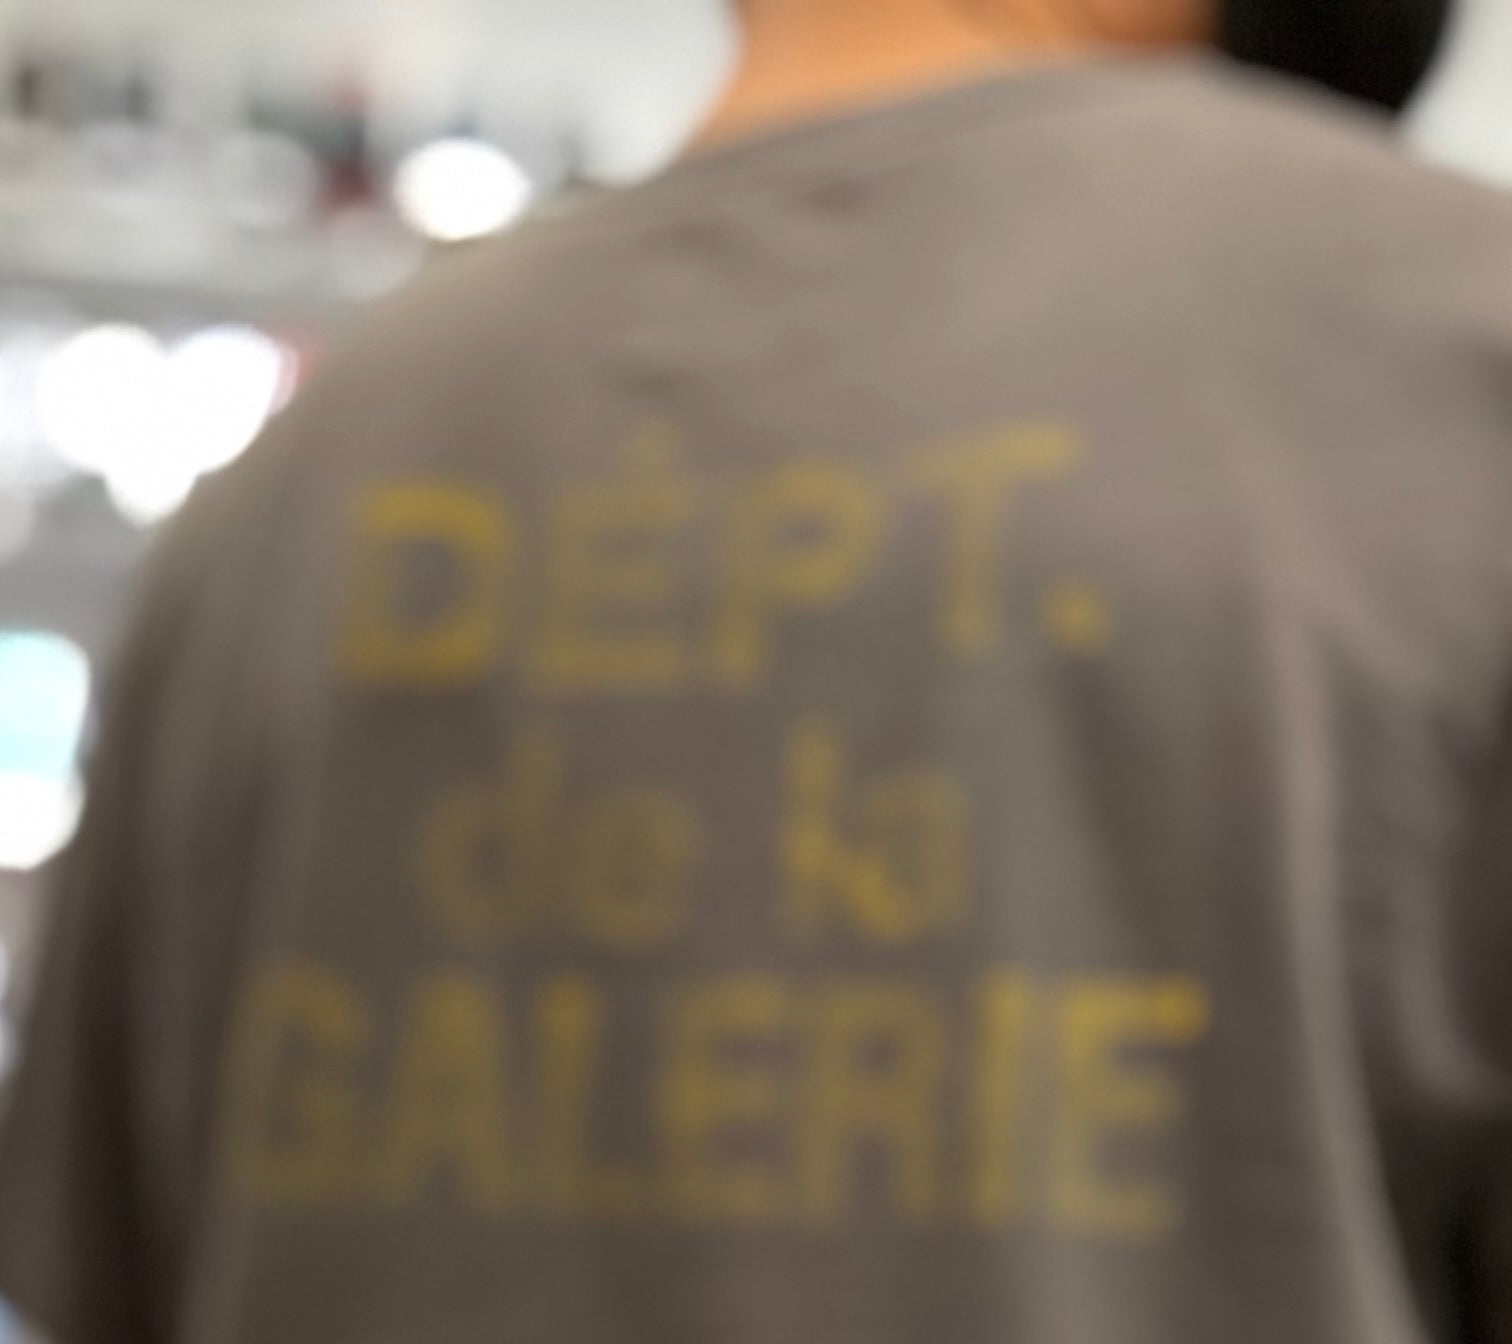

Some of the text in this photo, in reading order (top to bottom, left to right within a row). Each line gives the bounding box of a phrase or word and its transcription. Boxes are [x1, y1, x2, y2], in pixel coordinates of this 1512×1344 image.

[420, 715, 968, 944] de la
[220, 960, 1208, 1238] GALERIE
